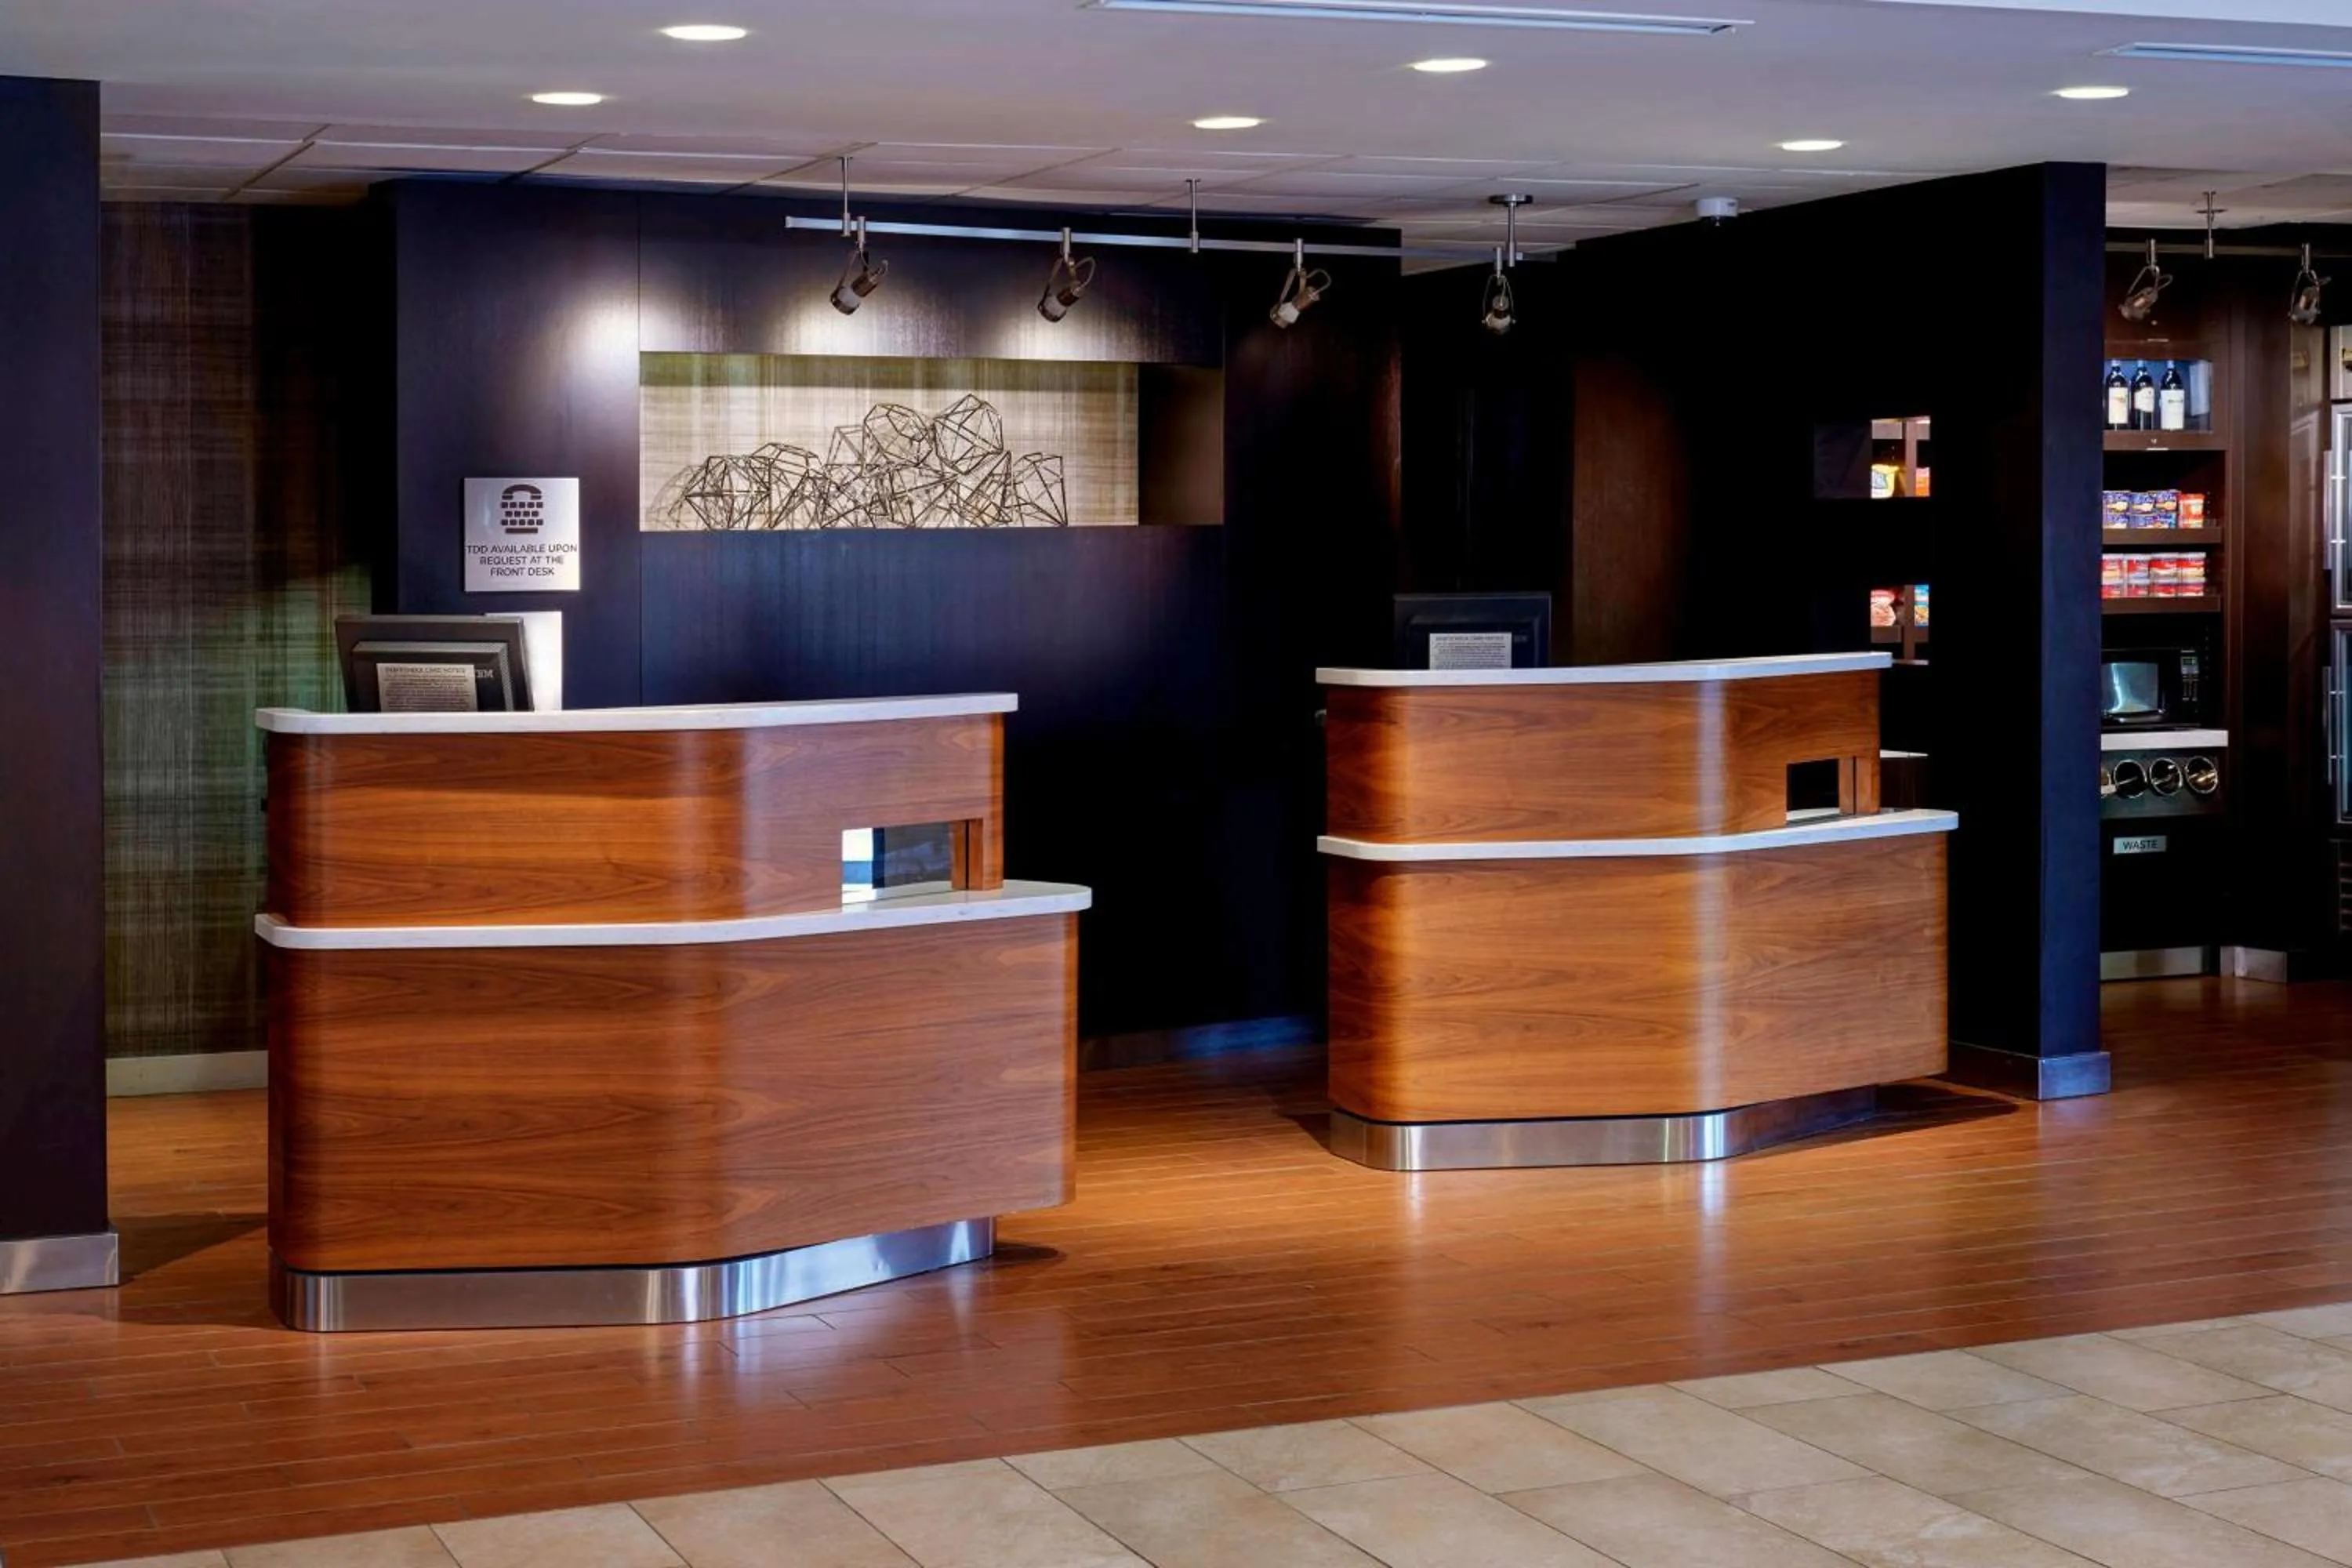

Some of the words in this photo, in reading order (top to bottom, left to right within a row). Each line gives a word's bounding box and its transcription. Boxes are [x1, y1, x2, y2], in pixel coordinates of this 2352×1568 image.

[466, 545, 488, 554] TDD
[490, 543, 546, 554] AVAILABLE
[548, 543, 578, 553] UPON
[479, 556, 527, 565] REQUEST
[529, 556, 542, 564] AT
[546, 555, 564, 564] THE
[490, 567, 526, 576] FRONT
[528, 567, 555, 576] DESK
[2122, 839, 2158, 851] WASTE
